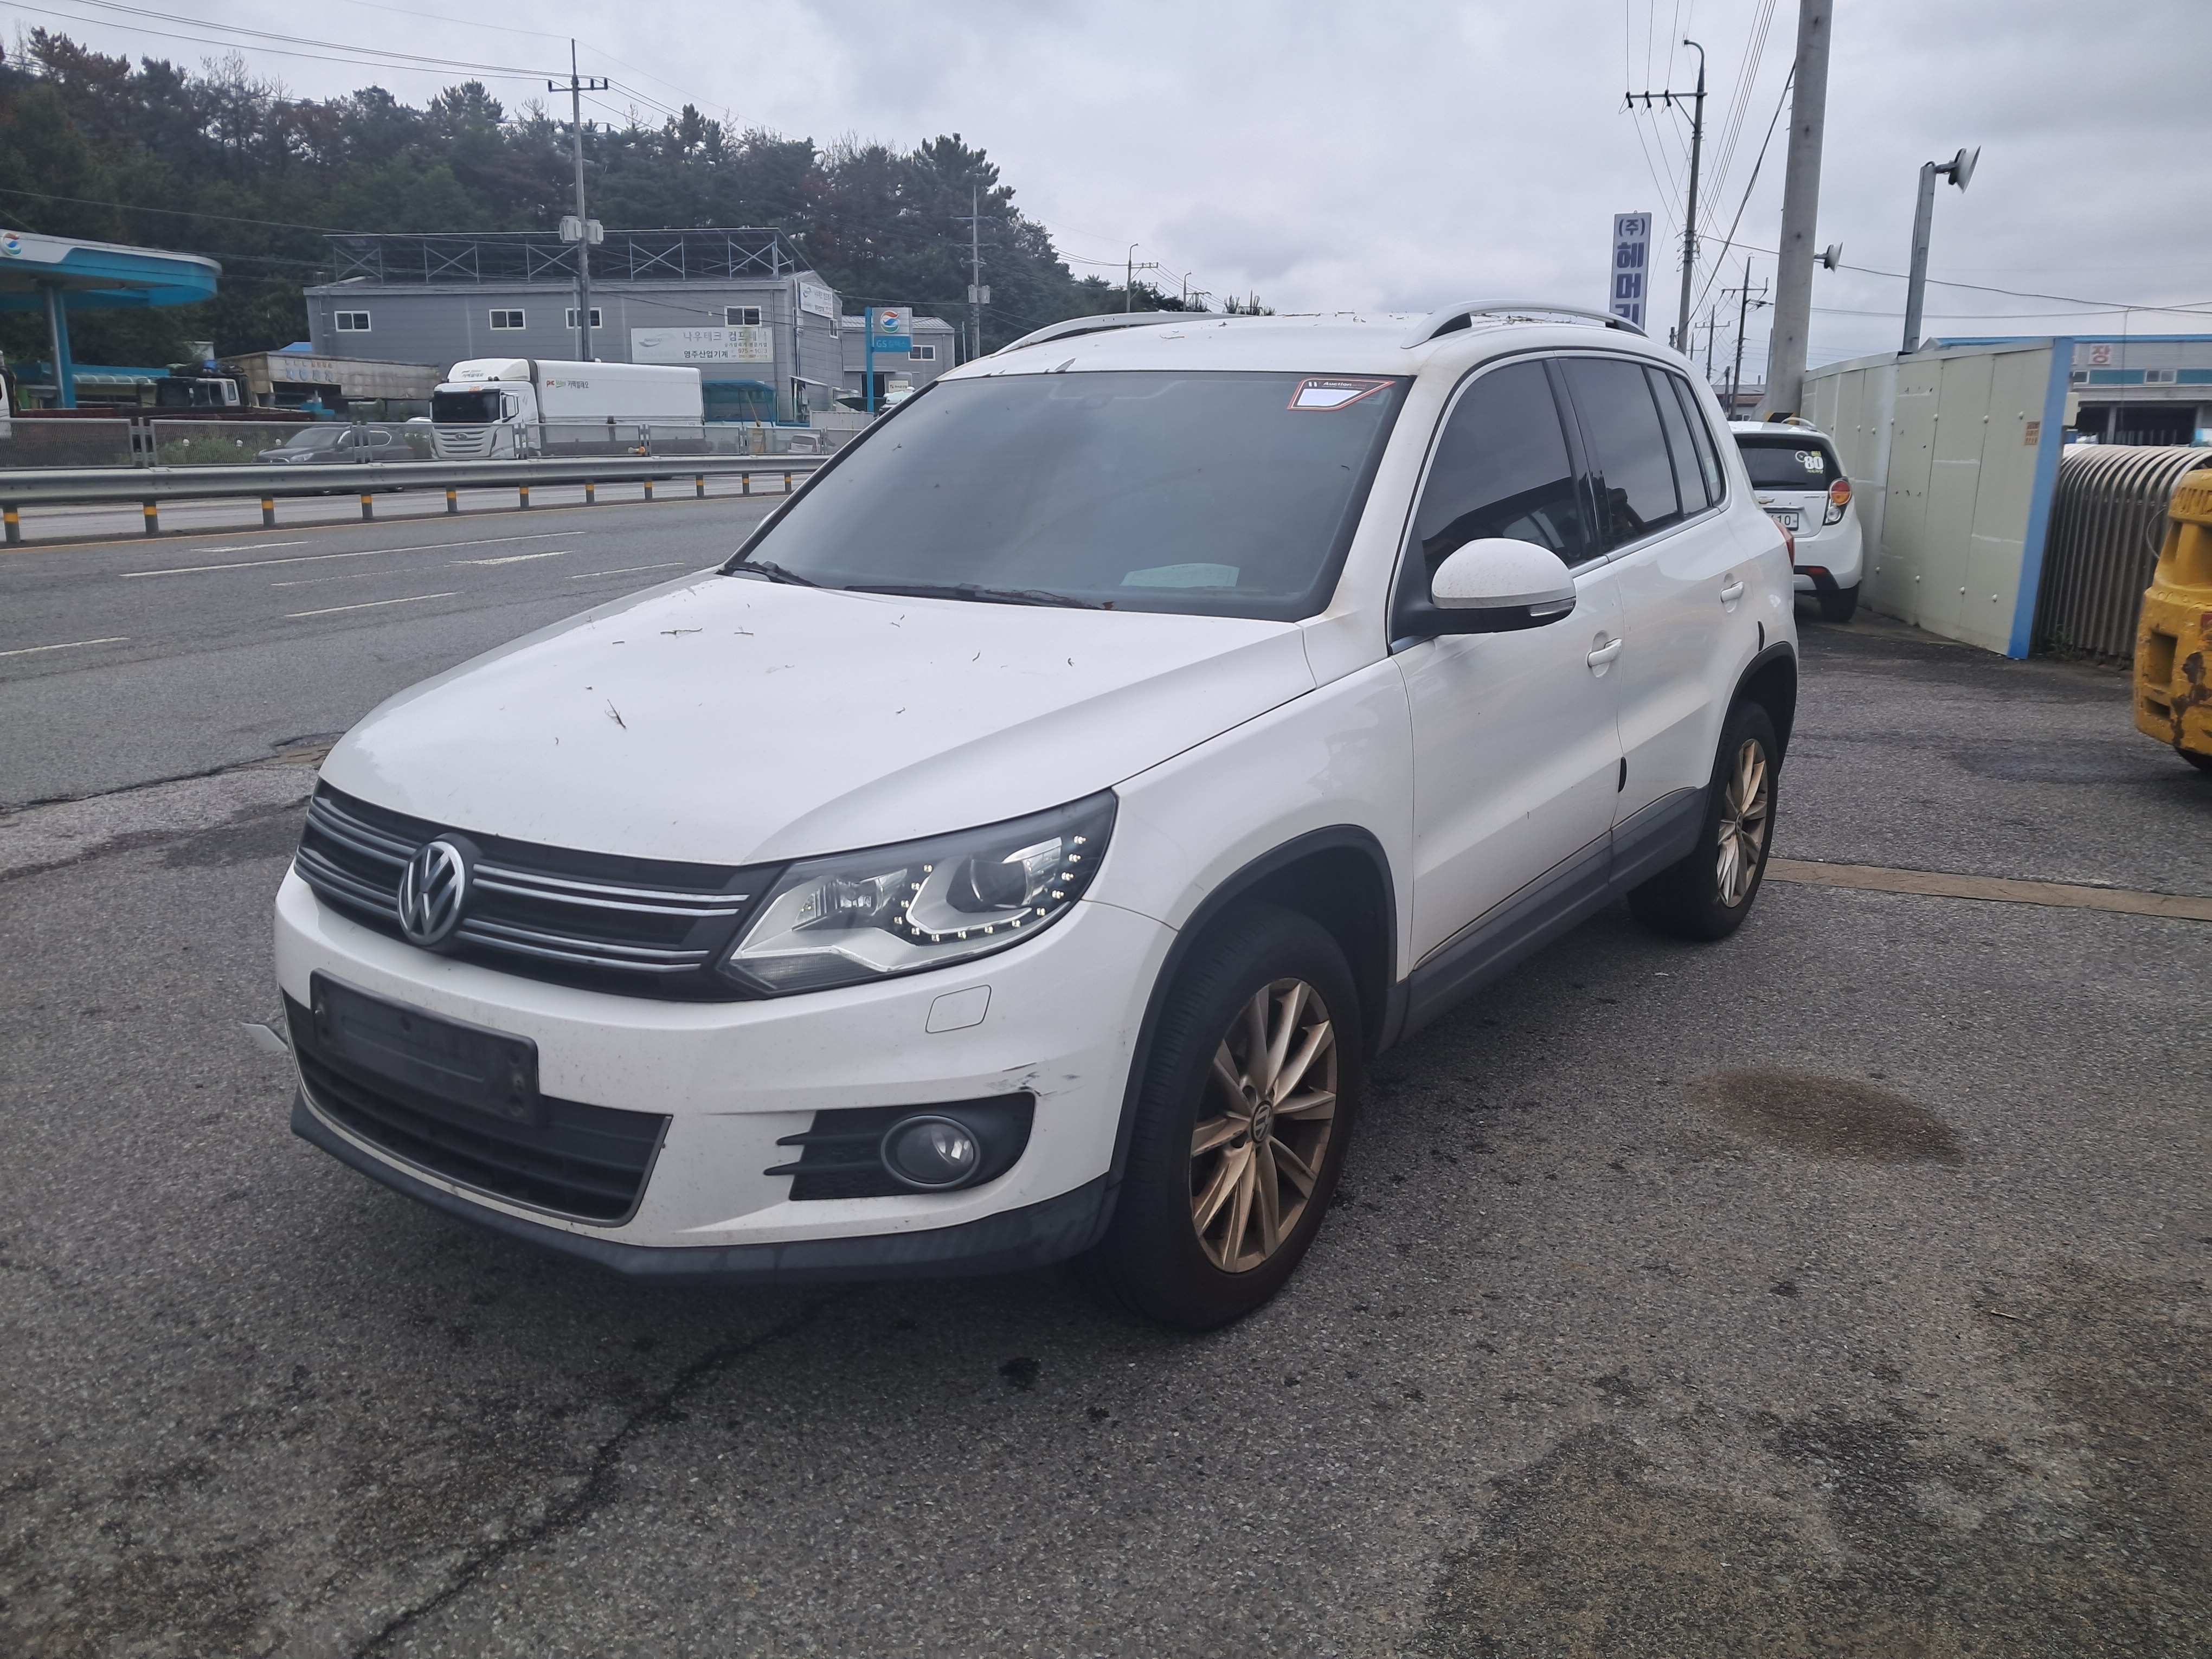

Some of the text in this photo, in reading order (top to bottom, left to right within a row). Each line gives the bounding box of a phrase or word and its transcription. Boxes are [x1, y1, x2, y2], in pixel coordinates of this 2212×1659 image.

[684, 331, 722, 342] 나우테크
[684, 350, 728, 358] 영주산업기계
[1804, 456, 1824, 470] 80
